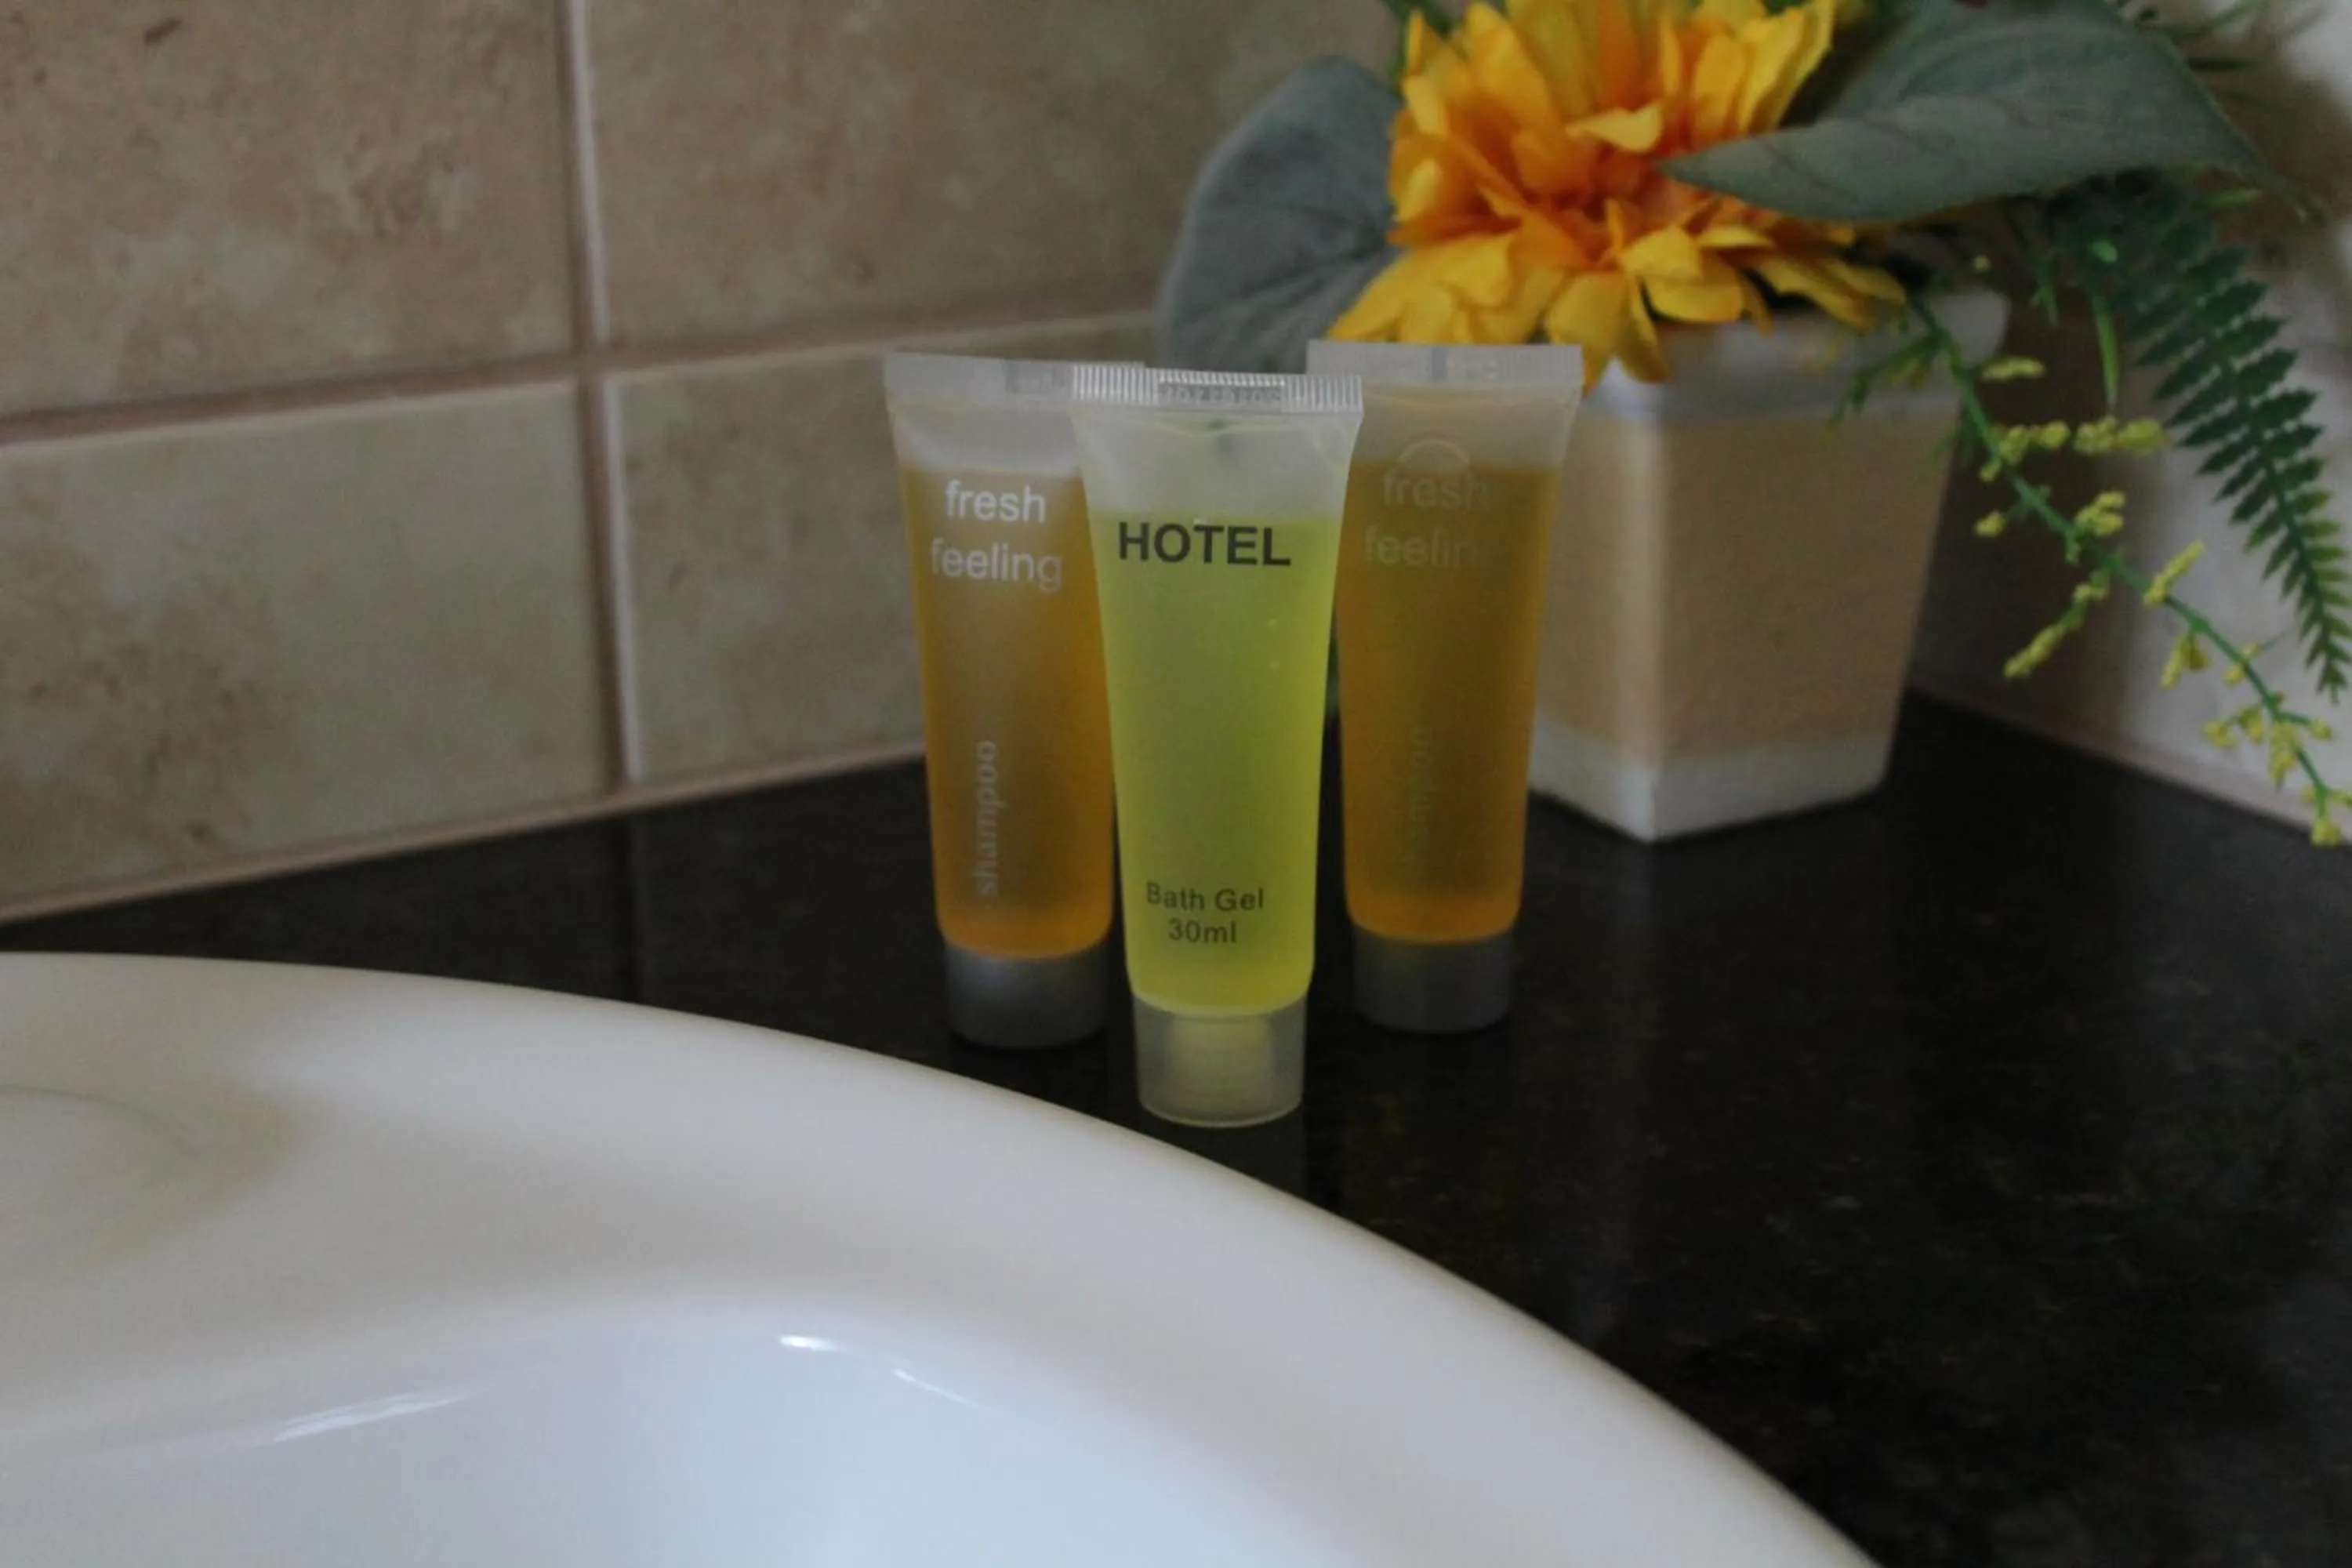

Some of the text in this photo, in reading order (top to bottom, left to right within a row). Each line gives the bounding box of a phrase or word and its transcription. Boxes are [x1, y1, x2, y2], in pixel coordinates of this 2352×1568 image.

[946, 479, 1046, 523] fresh
[931, 536, 1063, 593] feeling
[1118, 521, 1291, 566] HOTEL
[1364, 523, 1501, 579] feelin
[972, 739, 1008, 897] shampoo
[1146, 880, 1265, 912] Bath Gel
[1168, 916, 1237, 944] 30ml
